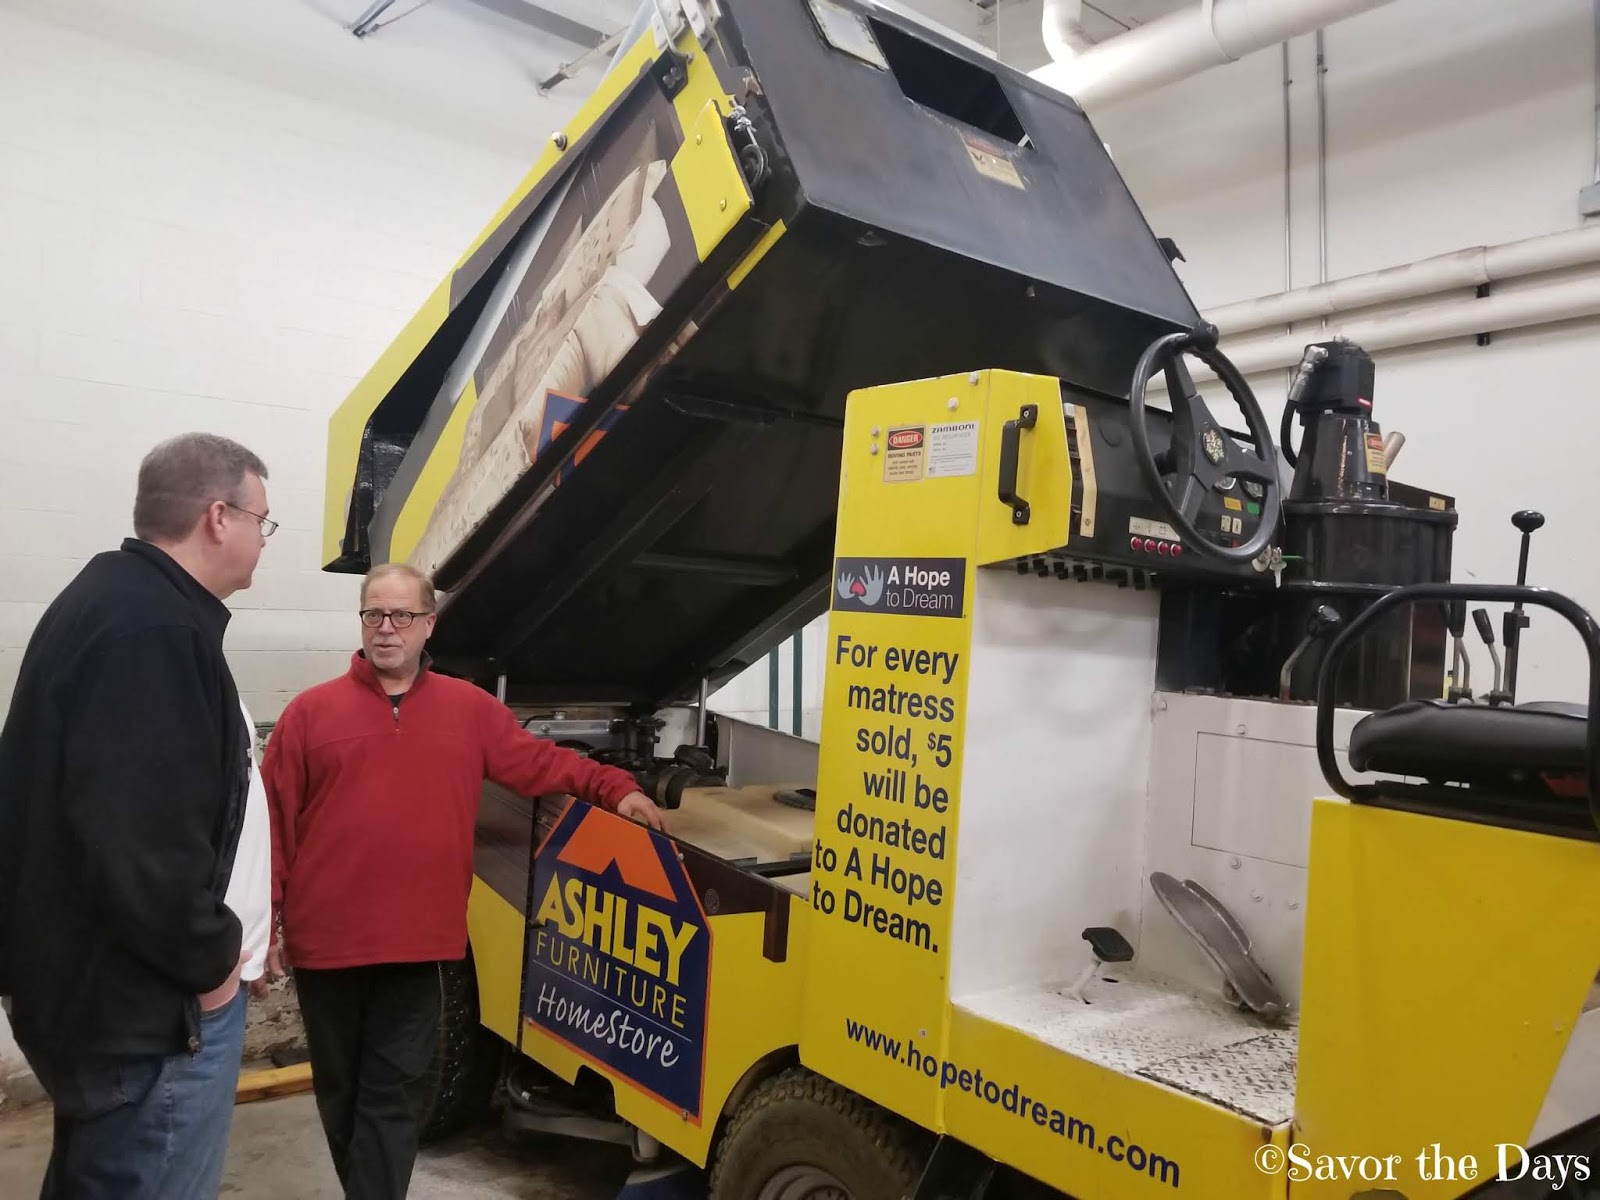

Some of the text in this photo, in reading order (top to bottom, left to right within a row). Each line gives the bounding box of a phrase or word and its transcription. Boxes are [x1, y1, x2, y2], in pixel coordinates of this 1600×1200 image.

[892, 434, 919, 445] DANGER
[931, 423, 975, 433] ZAMBONI
[886, 588, 954, 610] to Dream
[887, 566, 951, 590] A Hope
[836, 634, 959, 685] For every
[848, 684, 954, 723] matress
[856, 725, 952, 768] sold, $5
[863, 768, 949, 813] will be
[837, 803, 946, 860] donated
[815, 838, 943, 906] to A Hope
[535, 871, 699, 987] ASHLEY
[813, 880, 938, 954] to Dream.
[536, 930, 687, 1029] FURNITURE
[537, 982, 680, 1068] HomeStore
[846, 1018, 1181, 1189] www.hopetodream.com
